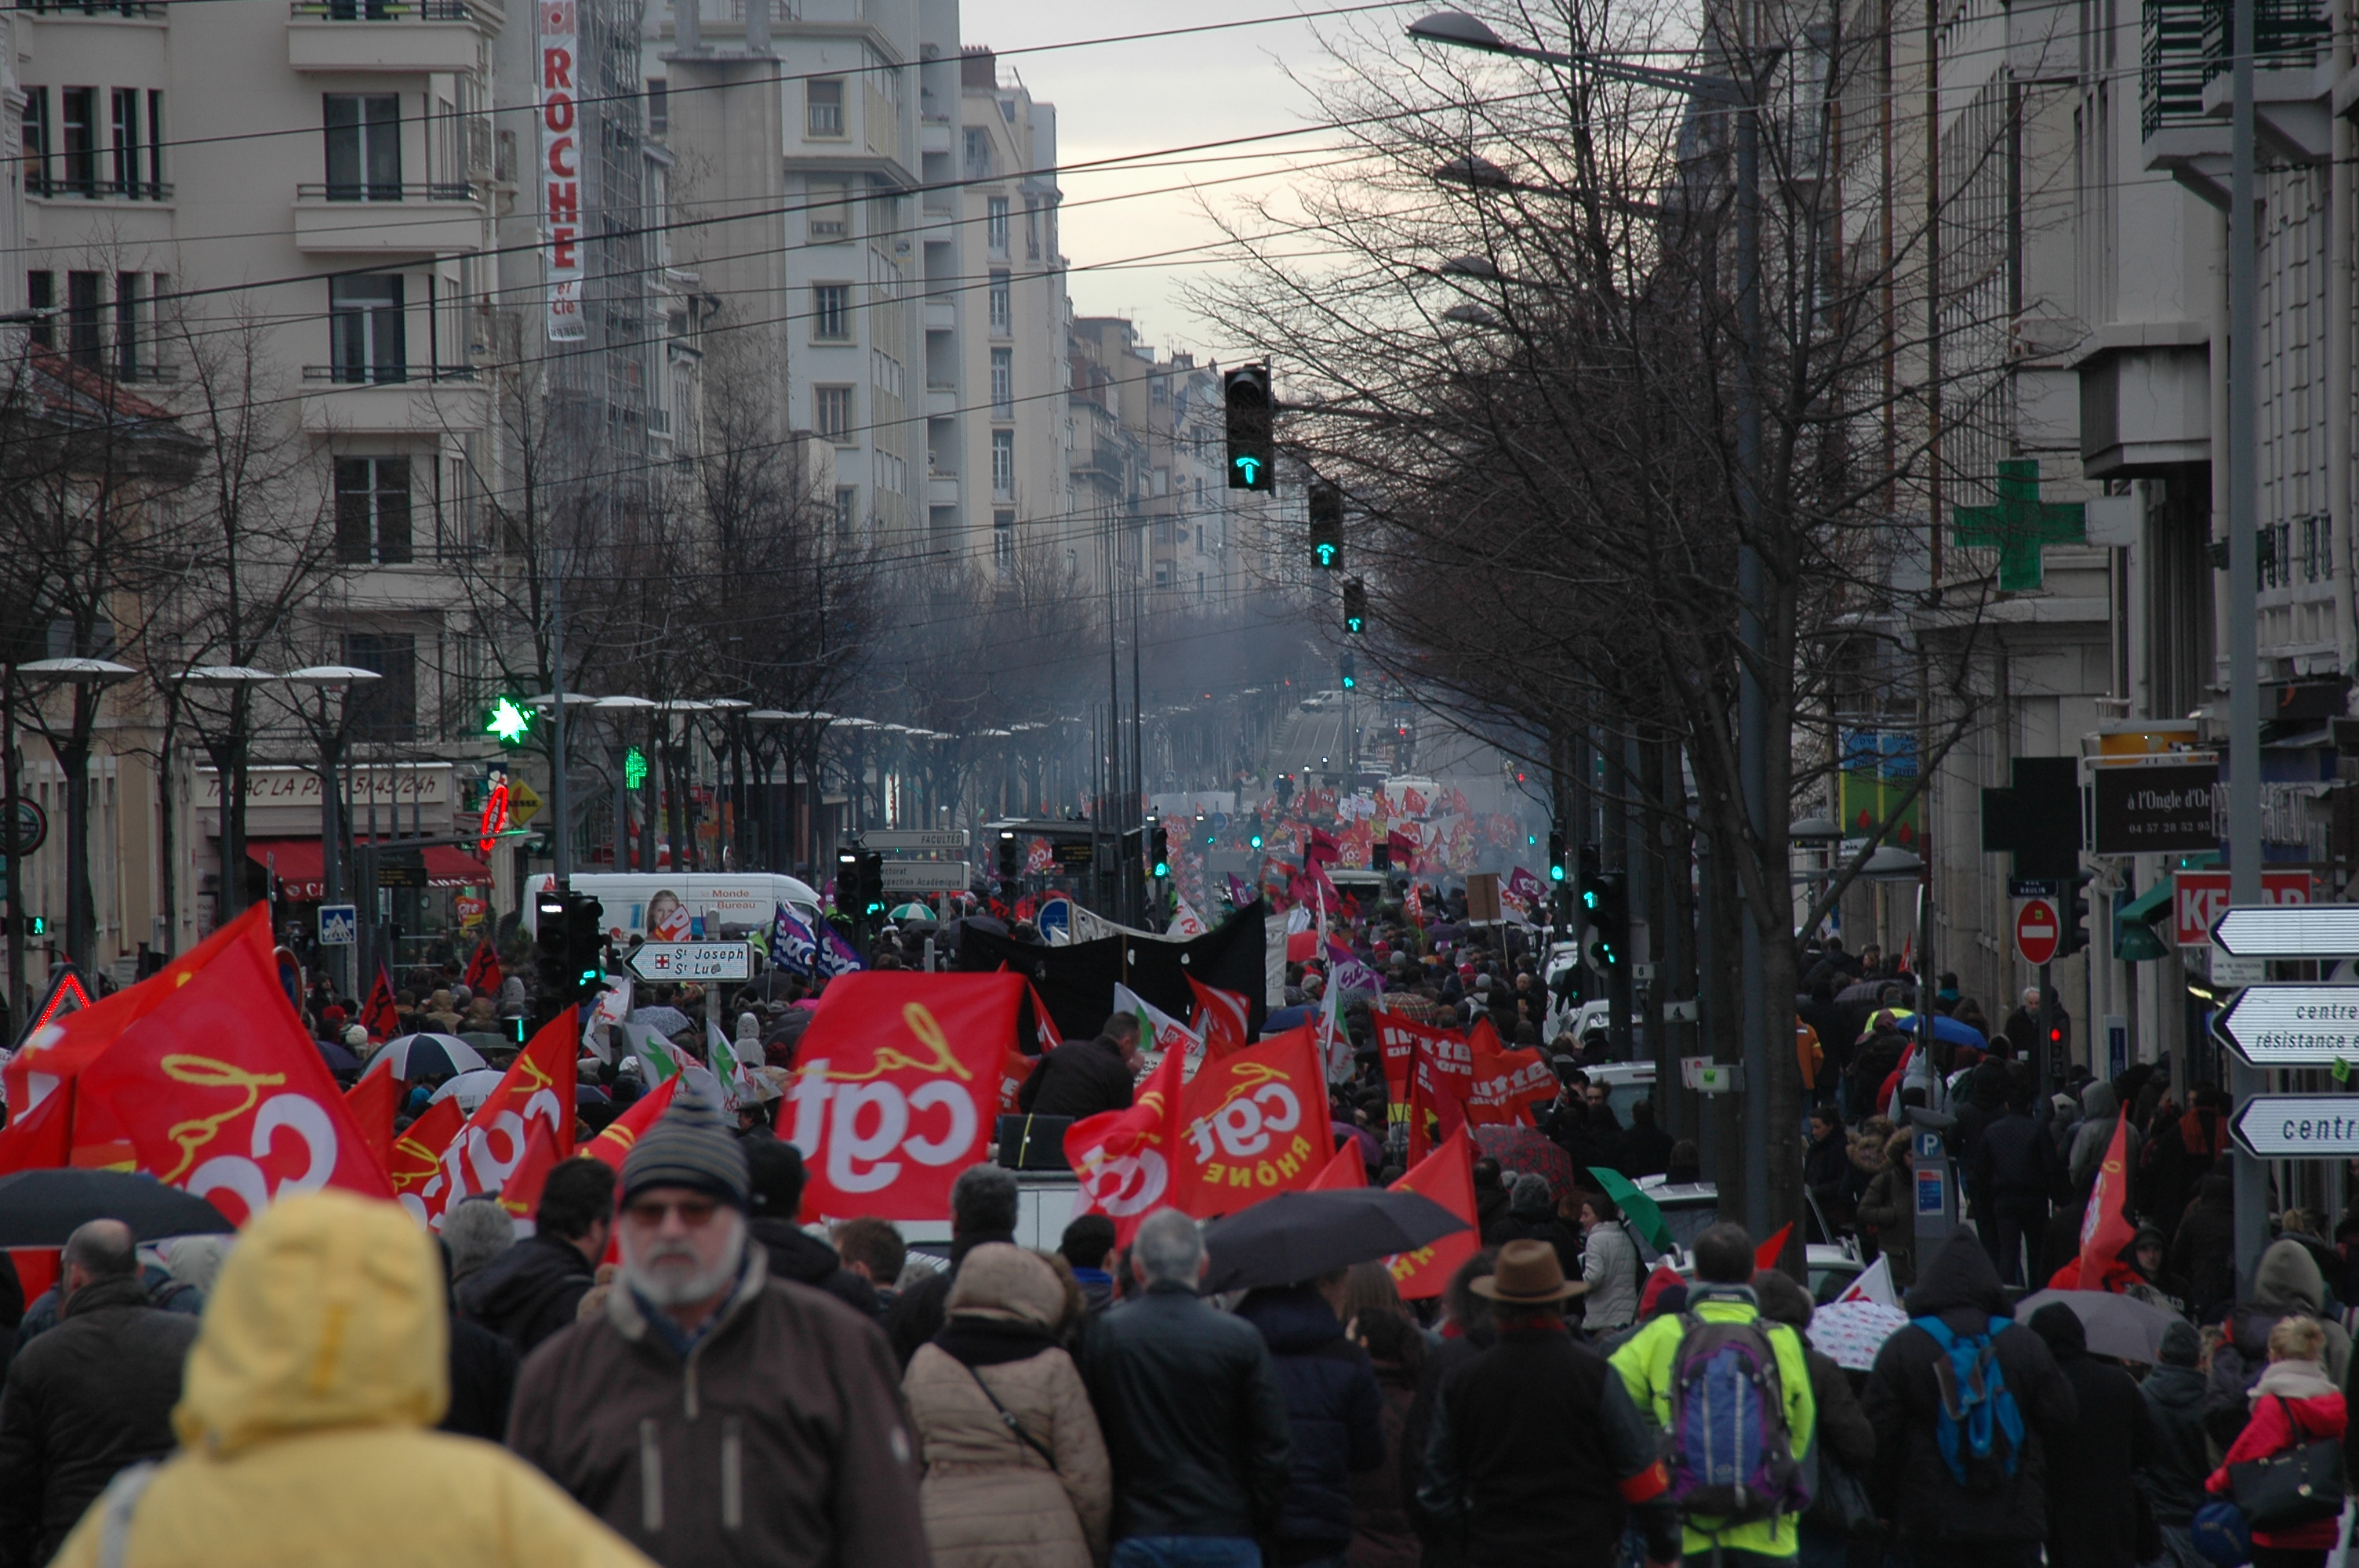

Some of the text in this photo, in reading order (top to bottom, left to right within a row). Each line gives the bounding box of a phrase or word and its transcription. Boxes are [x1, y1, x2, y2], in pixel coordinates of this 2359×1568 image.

[544, 48, 577, 268] ROCHE
[271, 776, 295, 796] LA
[2128, 789, 2211, 812] à l'Ongle d'Or
[2129, 826, 2142, 834] 04
[921, 834, 961, 844] FACULTÉS
[916, 877, 961, 890] Académique
[718, 901, 756, 909] Bureau
[695, 948, 743, 961] Joseph
[1638, 966, 1645, 977] 6
[1673, 1006, 1681, 1018] 4
[2295, 1004, 2358, 1019] centre
[1383, 1027, 1472, 1062] lutte
[2255, 1030, 2346, 1048] résistance
